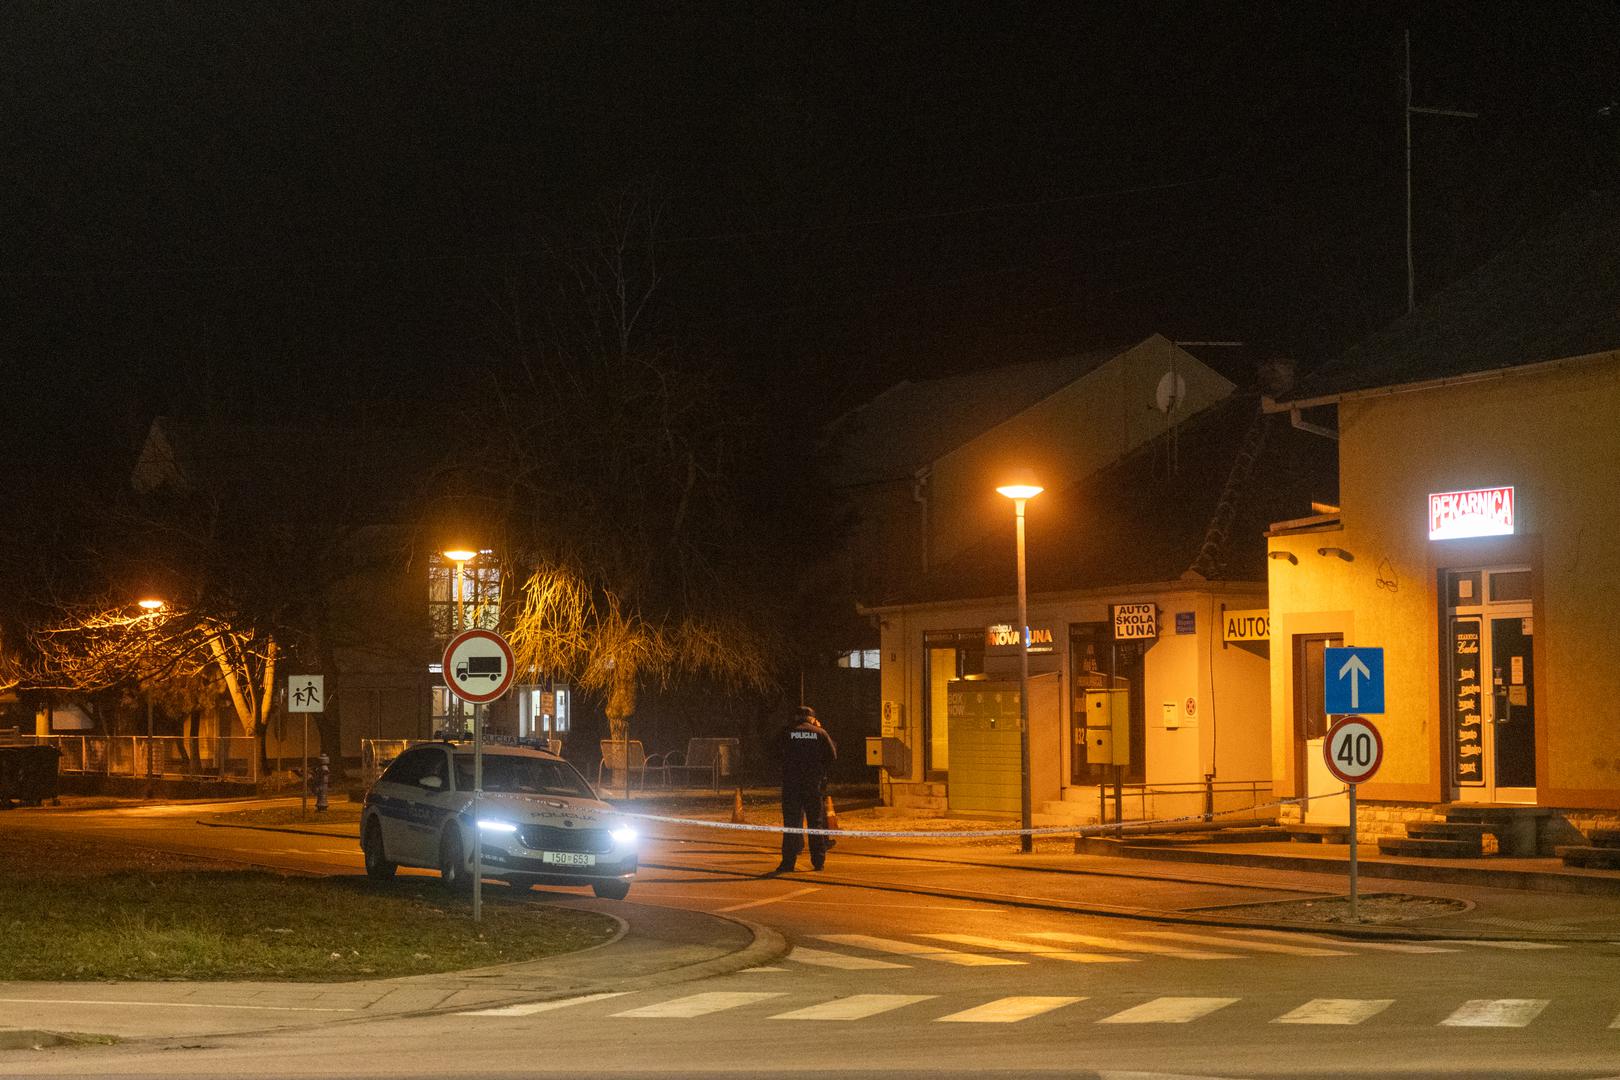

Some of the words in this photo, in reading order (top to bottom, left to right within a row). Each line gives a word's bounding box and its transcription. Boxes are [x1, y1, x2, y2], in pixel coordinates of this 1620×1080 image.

[1432, 490, 1513, 531] PEKARNICA
[1119, 604, 1150, 614] AUTO
[1115, 613, 1154, 625] ŠKOLA
[1117, 624, 1155, 637] LUNA
[481, 735, 517, 745] OLICIJA
[1337, 733, 1371, 767] 40
[573, 854, 589, 864] 653
